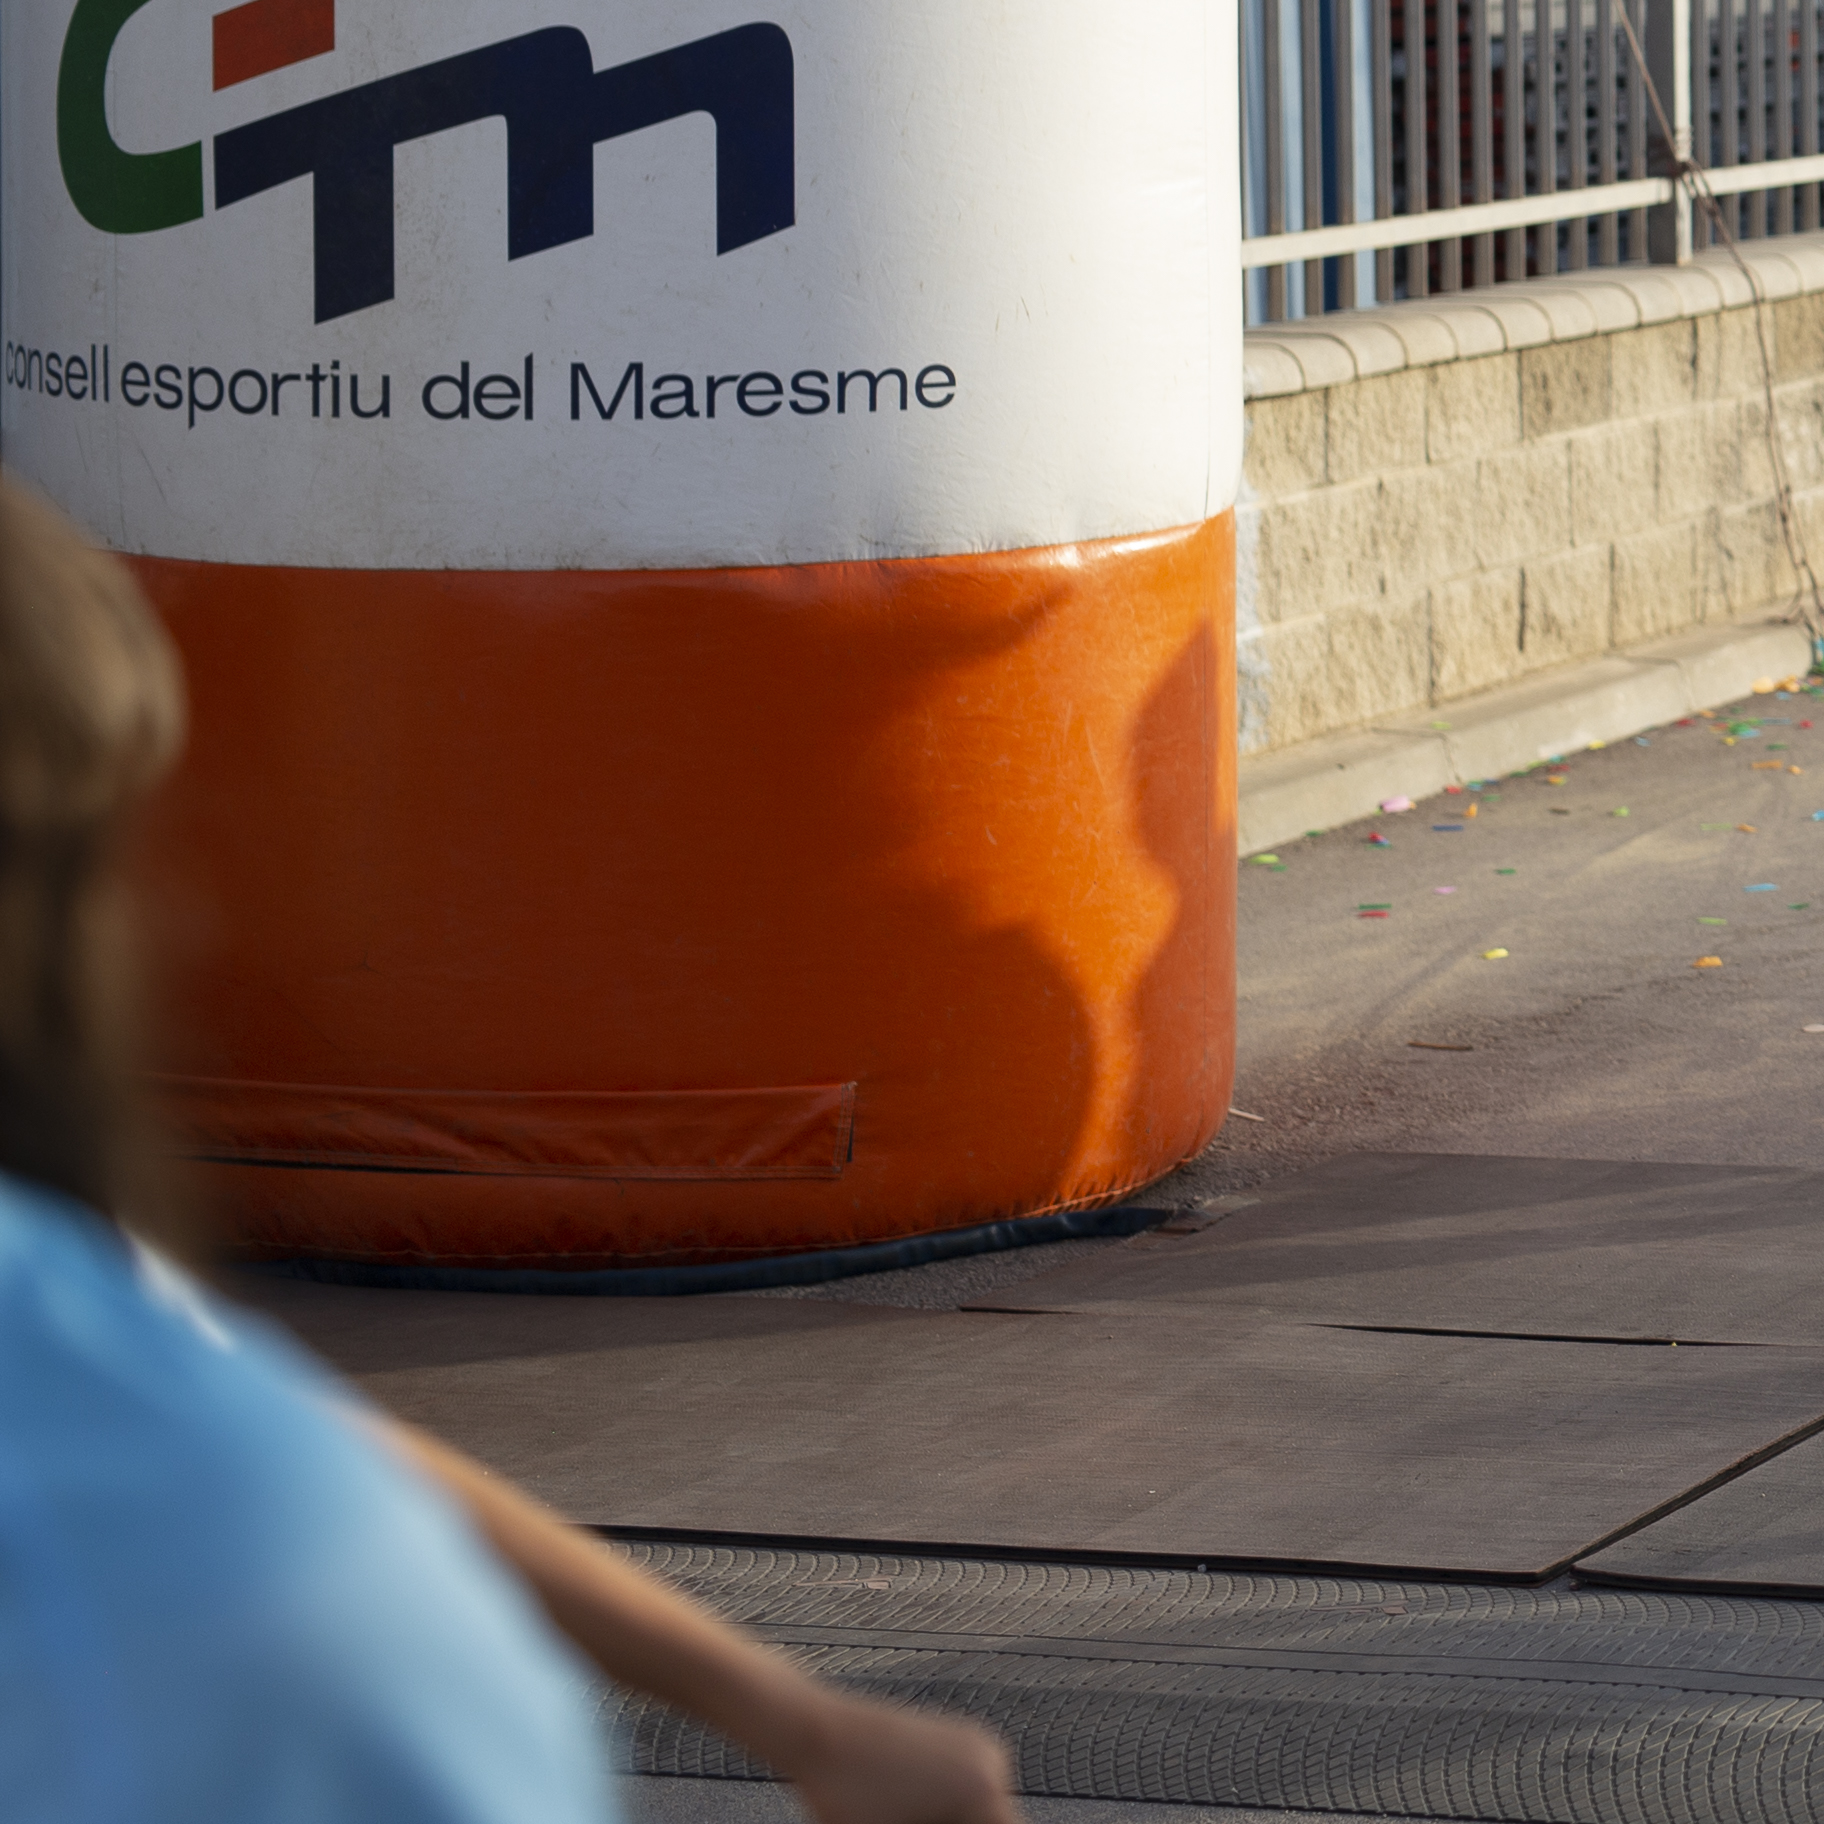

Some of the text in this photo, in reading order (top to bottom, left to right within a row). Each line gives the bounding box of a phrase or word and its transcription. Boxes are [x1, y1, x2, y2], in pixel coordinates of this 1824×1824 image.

[5, 339, 958, 431] consell esportiu del Maresme
